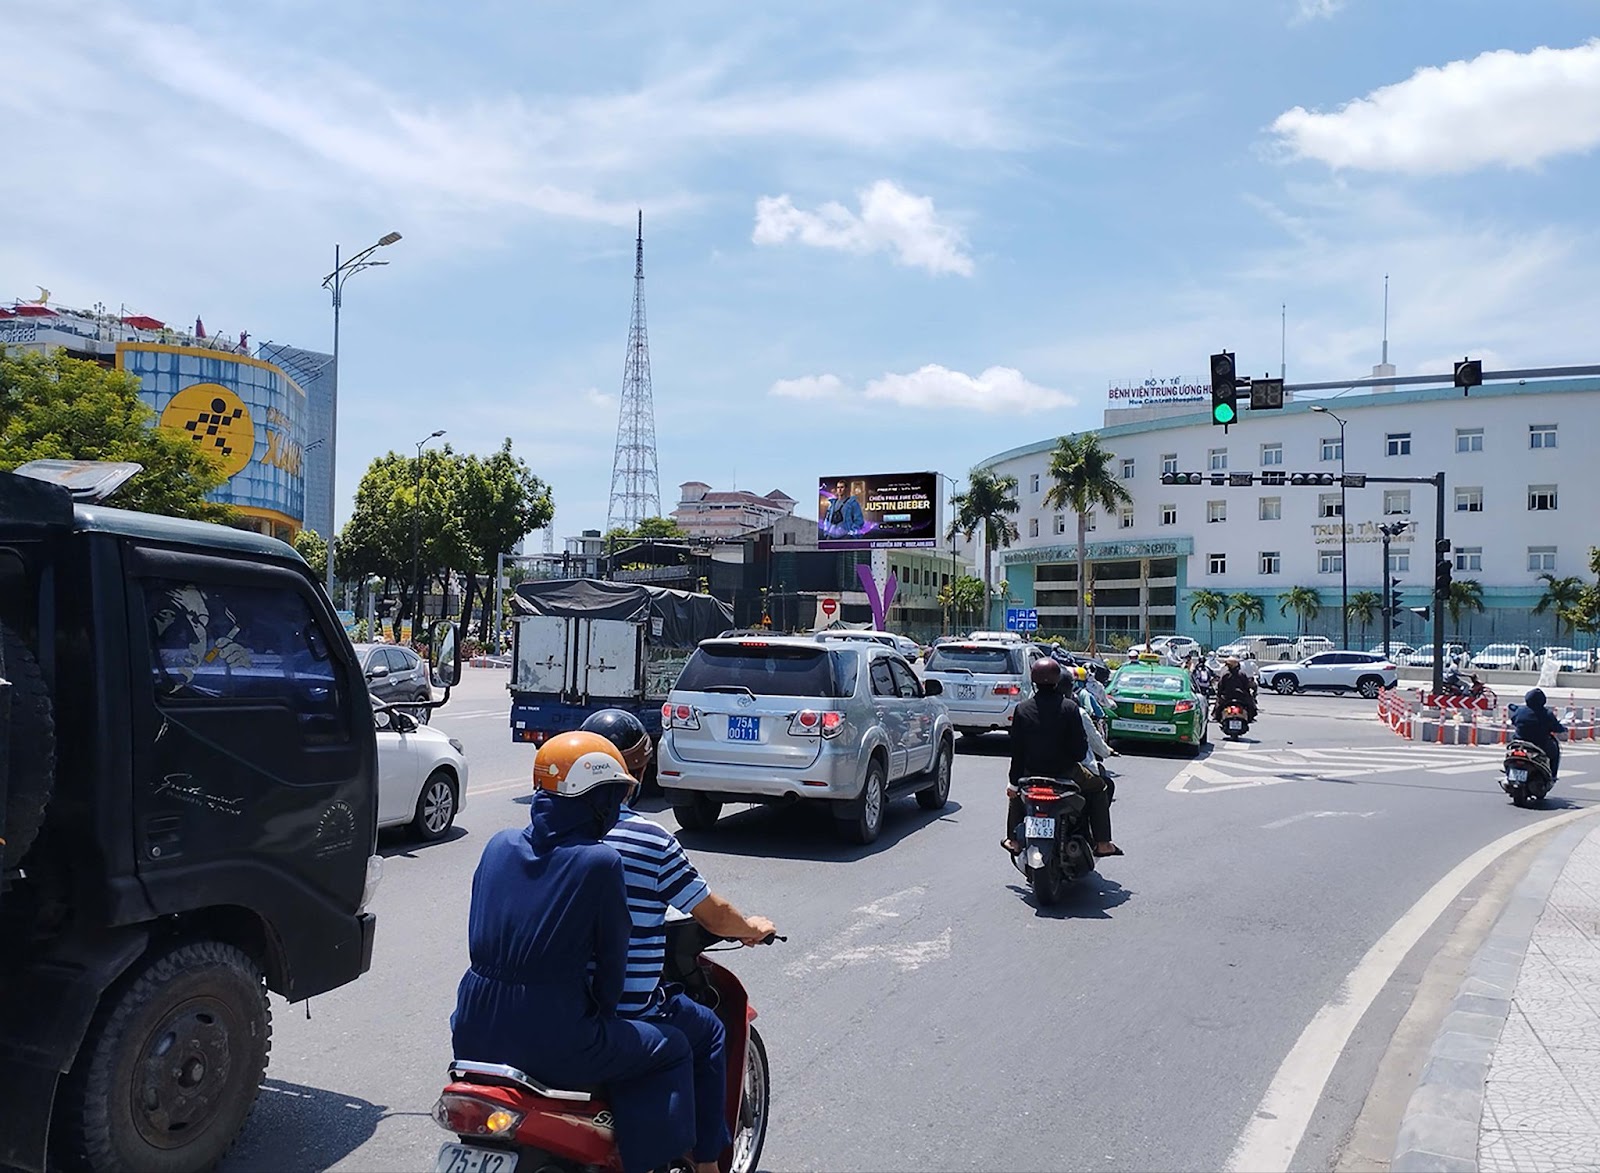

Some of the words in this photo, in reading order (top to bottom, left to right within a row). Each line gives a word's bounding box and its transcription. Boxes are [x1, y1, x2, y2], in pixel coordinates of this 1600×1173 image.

[0, 328, 35, 342] OFFEE
[1159, 378, 1166, 386] Y
[1170, 375, 1182, 385] TẾ
[1108, 386, 1130, 399] BỆNH
[1131, 385, 1150, 399] VIỆN
[1151, 386, 1178, 397] TRUNG
[865, 501, 896, 511] JUSTIN
[897, 500, 930, 510] BIEBER
[1310, 523, 1354, 536] TRUNG
[735, 716, 753, 729] 75A
[728, 727, 759, 740] 001.11
[1030, 818, 1051, 828] 74-01
